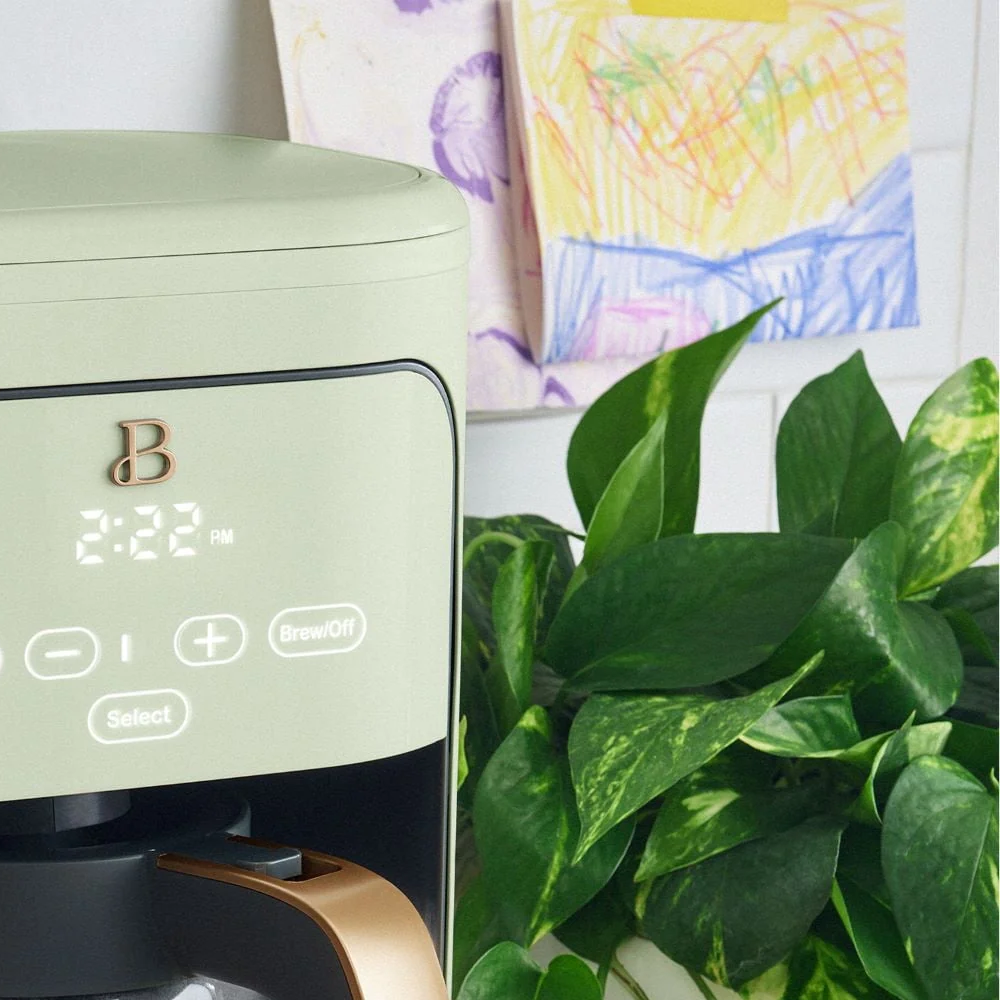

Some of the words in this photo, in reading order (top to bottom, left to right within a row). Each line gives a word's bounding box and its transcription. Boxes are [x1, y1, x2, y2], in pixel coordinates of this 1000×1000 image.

[76, 502, 200, 565] 2:22
[210, 528, 234, 546] PM
[279, 617, 356, 643] Brew/Off
[106, 703, 173, 730] Select
